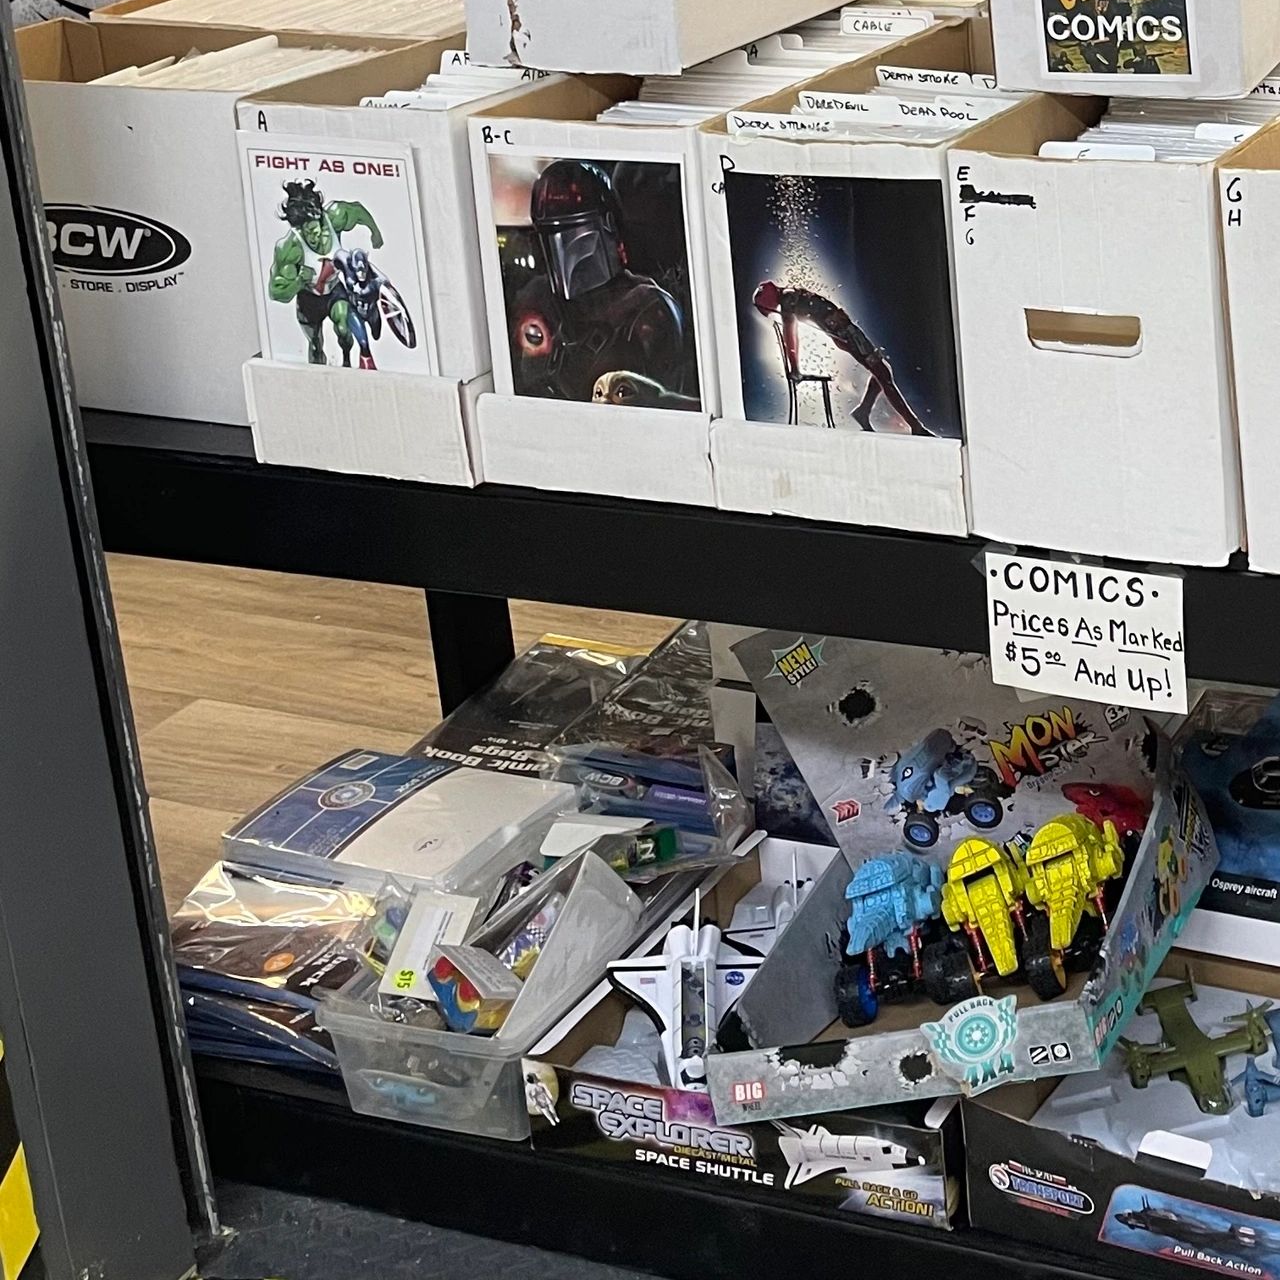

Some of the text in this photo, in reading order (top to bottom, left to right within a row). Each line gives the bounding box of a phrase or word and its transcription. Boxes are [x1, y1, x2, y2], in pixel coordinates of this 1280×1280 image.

[853, 19, 894, 33] CABLE
[1047, 14, 1183, 42] COMICS
[880, 68, 914, 84] DEATH
[805, 95, 870, 113] DAREDEVIL
[899, 103, 979, 122] DEAD POOL
[257, 110, 269, 132] A
[482, 126, 515, 146] B-C
[255, 154, 401, 178] FIGHT AS ONE!
[957, 165, 971, 182] E
[1226, 176, 1243, 203] G
[964, 206, 976, 222] F
[1228, 208, 1243, 228] H
[70, 278, 114, 293] STORE
[1003, 561, 1146, 608] COMICS
[992, 599, 1184, 653] Prices As Marked
[777, 641, 816, 676] NEW
[785, 659, 819, 687] STYLE!
[1074, 657, 1173, 701] And Up!
[422, 746, 483, 767] Book
[988, 704, 1082, 788] MON
[586, 772, 626, 787] BCW
[1211, 877, 1278, 899] Osprey aircraft
[396, 969, 414, 989] $15
[948, 998, 995, 1023] PULL BACK
[573, 1083, 664, 1121] SPACE
[734, 1082, 763, 1102] BIG
[741, 1102, 762, 1113] WHEEL
[598, 1109, 755, 1160] EXPLORER
[635, 1149, 775, 1187] SPACE SHUTTLE
[674, 1145, 757, 1168] DIECAST METAL
[834, 1176, 861, 1190] PULL
[863, 1181, 890, 1195] BACK
[902, 1190, 918, 1200] GO
[1009, 1173, 1086, 1209] TRANSPORT
[866, 1194, 935, 1218] ACTION!
[1173, 1245, 1263, 1277] Pull Back Action
